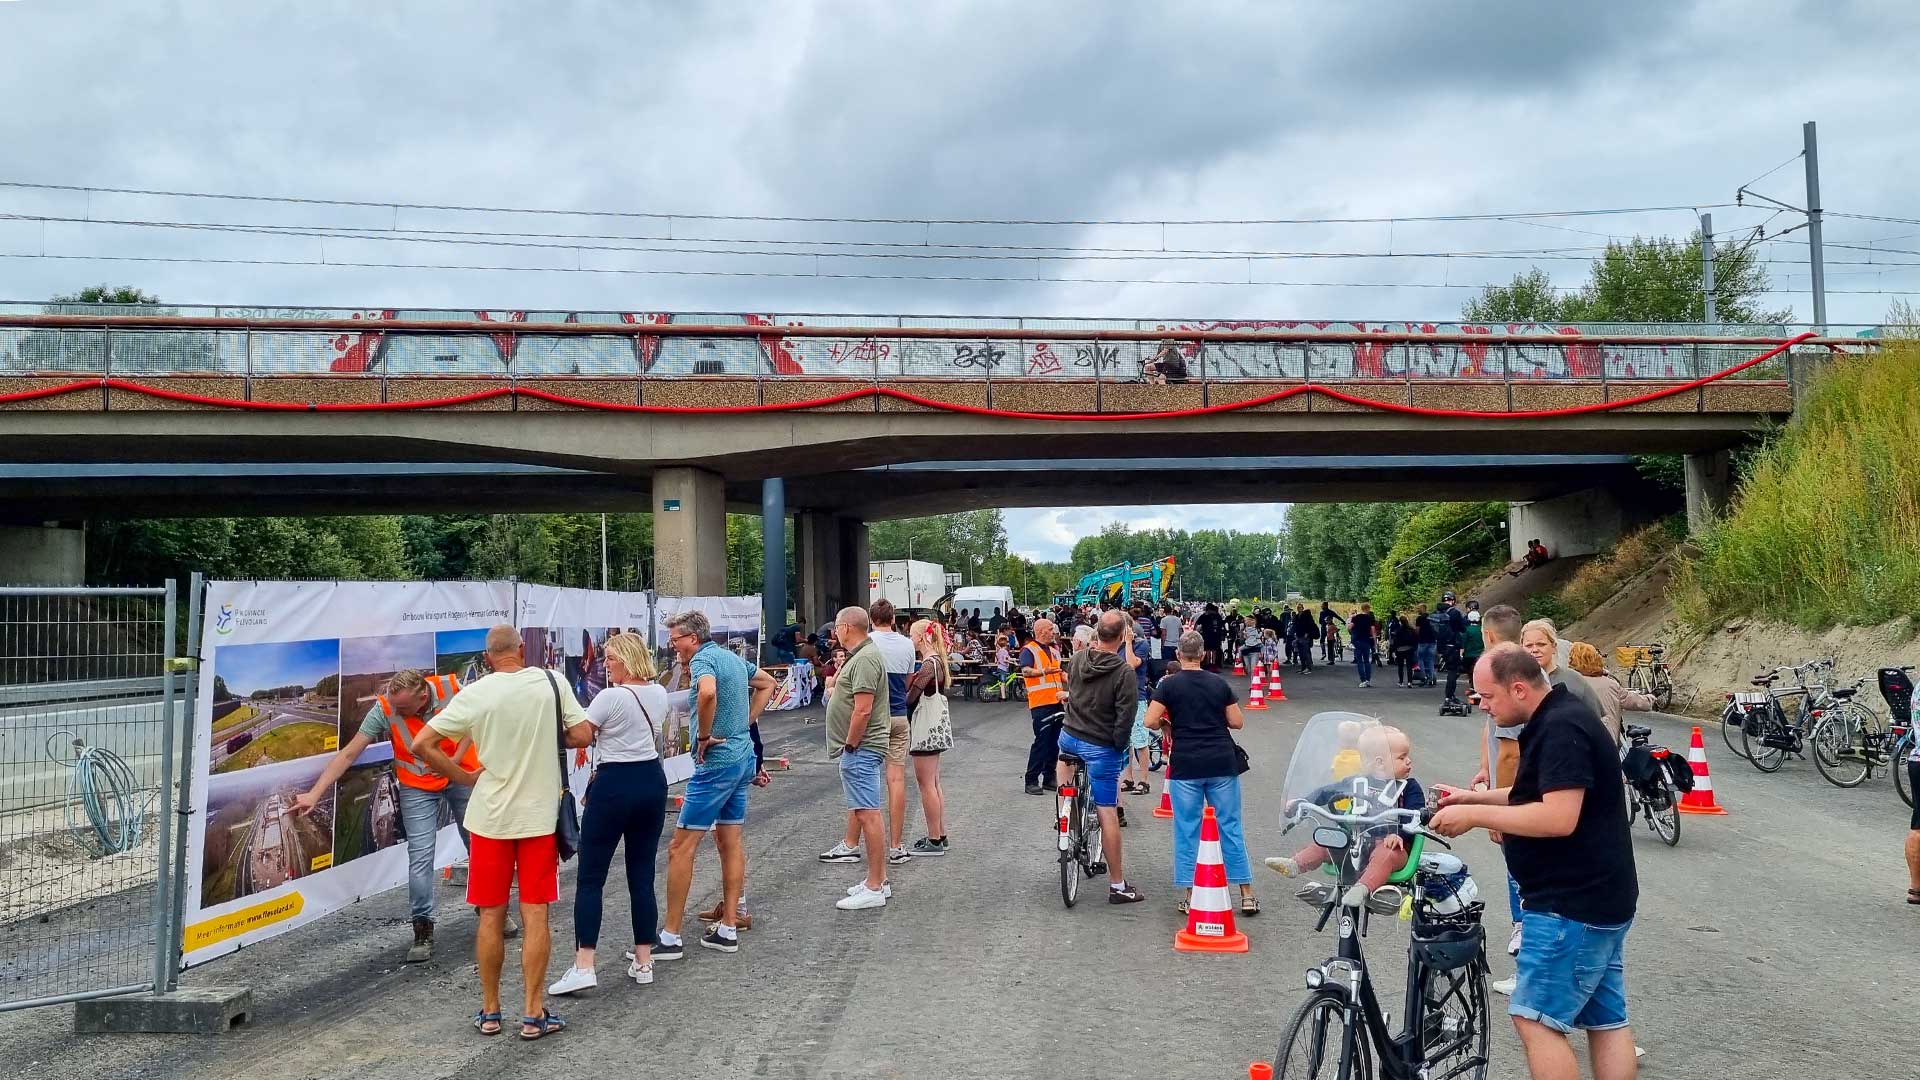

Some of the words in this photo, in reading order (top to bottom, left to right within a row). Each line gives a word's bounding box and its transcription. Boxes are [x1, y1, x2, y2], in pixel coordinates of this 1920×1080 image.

[234, 608, 266, 617] PROVINCIE
[235, 618, 268, 626] FLEVOLAND
[197, 930, 212, 940] Meer
